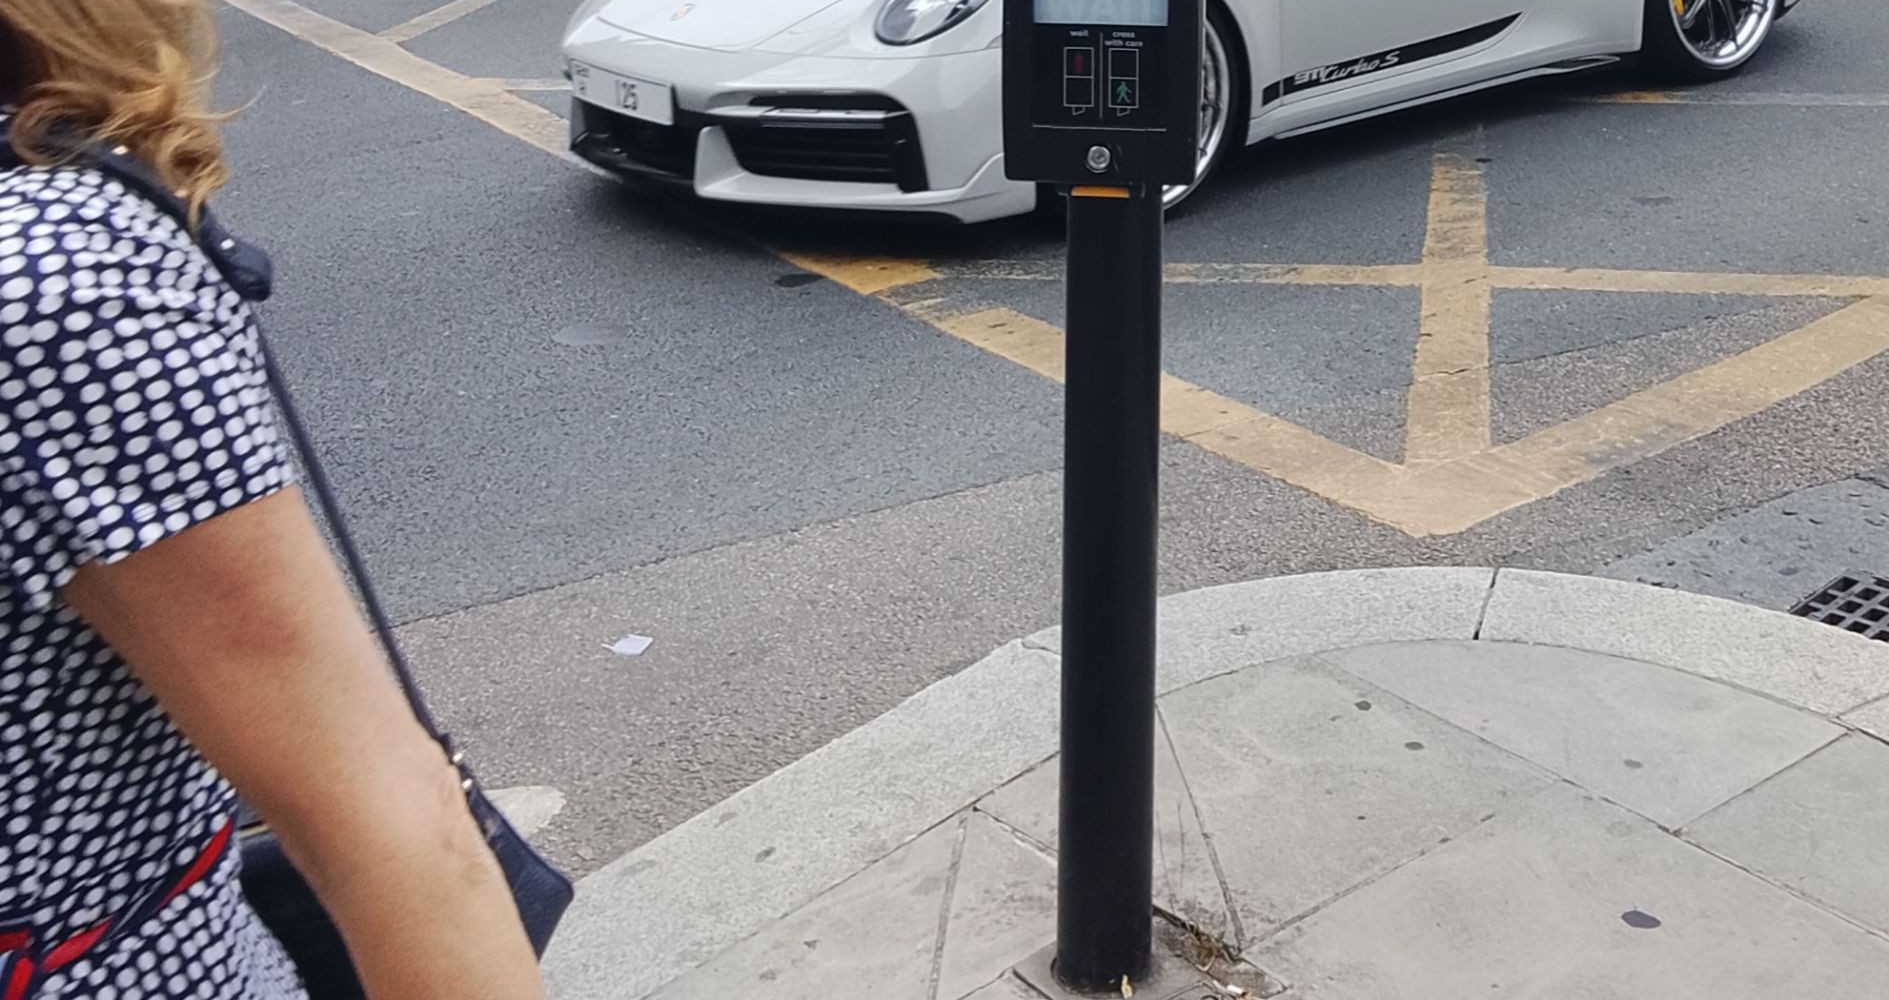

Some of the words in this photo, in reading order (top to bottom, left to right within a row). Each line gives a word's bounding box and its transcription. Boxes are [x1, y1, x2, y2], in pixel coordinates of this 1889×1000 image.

[1070, 29, 1088, 37] wait
[1105, 39, 1123, 47] with
[1318, 58, 1380, 83] Turbo
[1380, 50, 1400, 67] S
